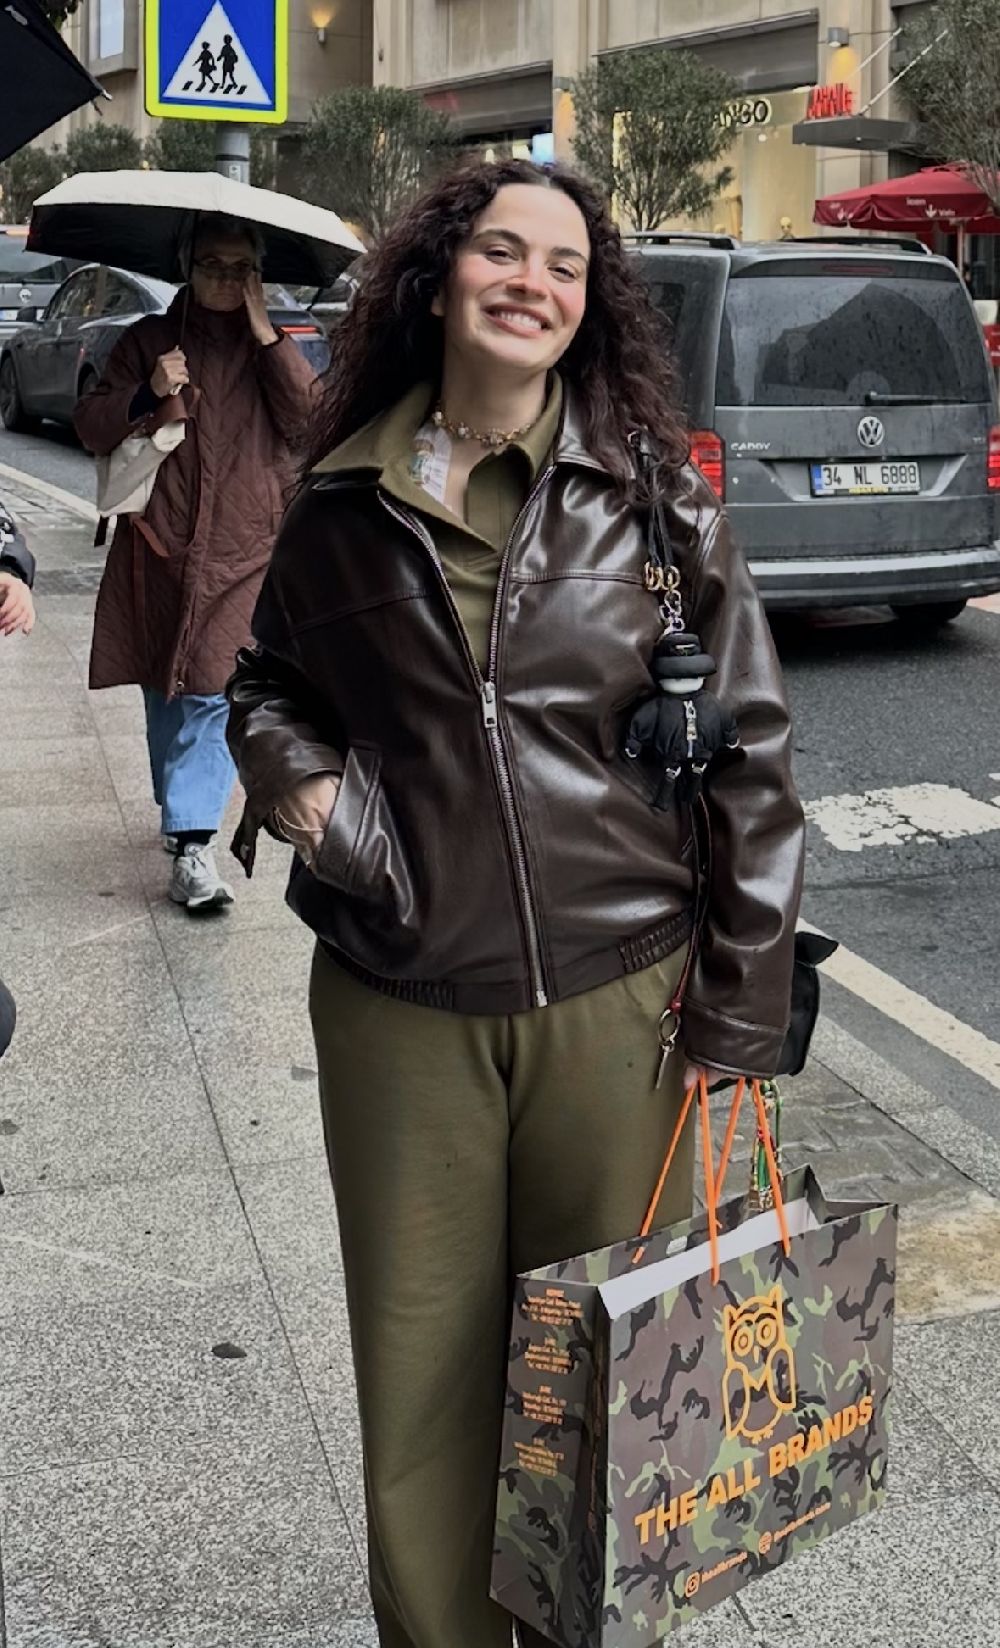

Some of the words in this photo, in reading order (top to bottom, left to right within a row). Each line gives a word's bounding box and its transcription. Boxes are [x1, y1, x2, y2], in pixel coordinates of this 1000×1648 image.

[823, 466, 842, 486] 34
[854, 466, 872, 485] NL
[634, 1487, 699, 1545] THE
[706, 1459, 761, 1511] ALL
[769, 1395, 874, 1477] BRANDS
